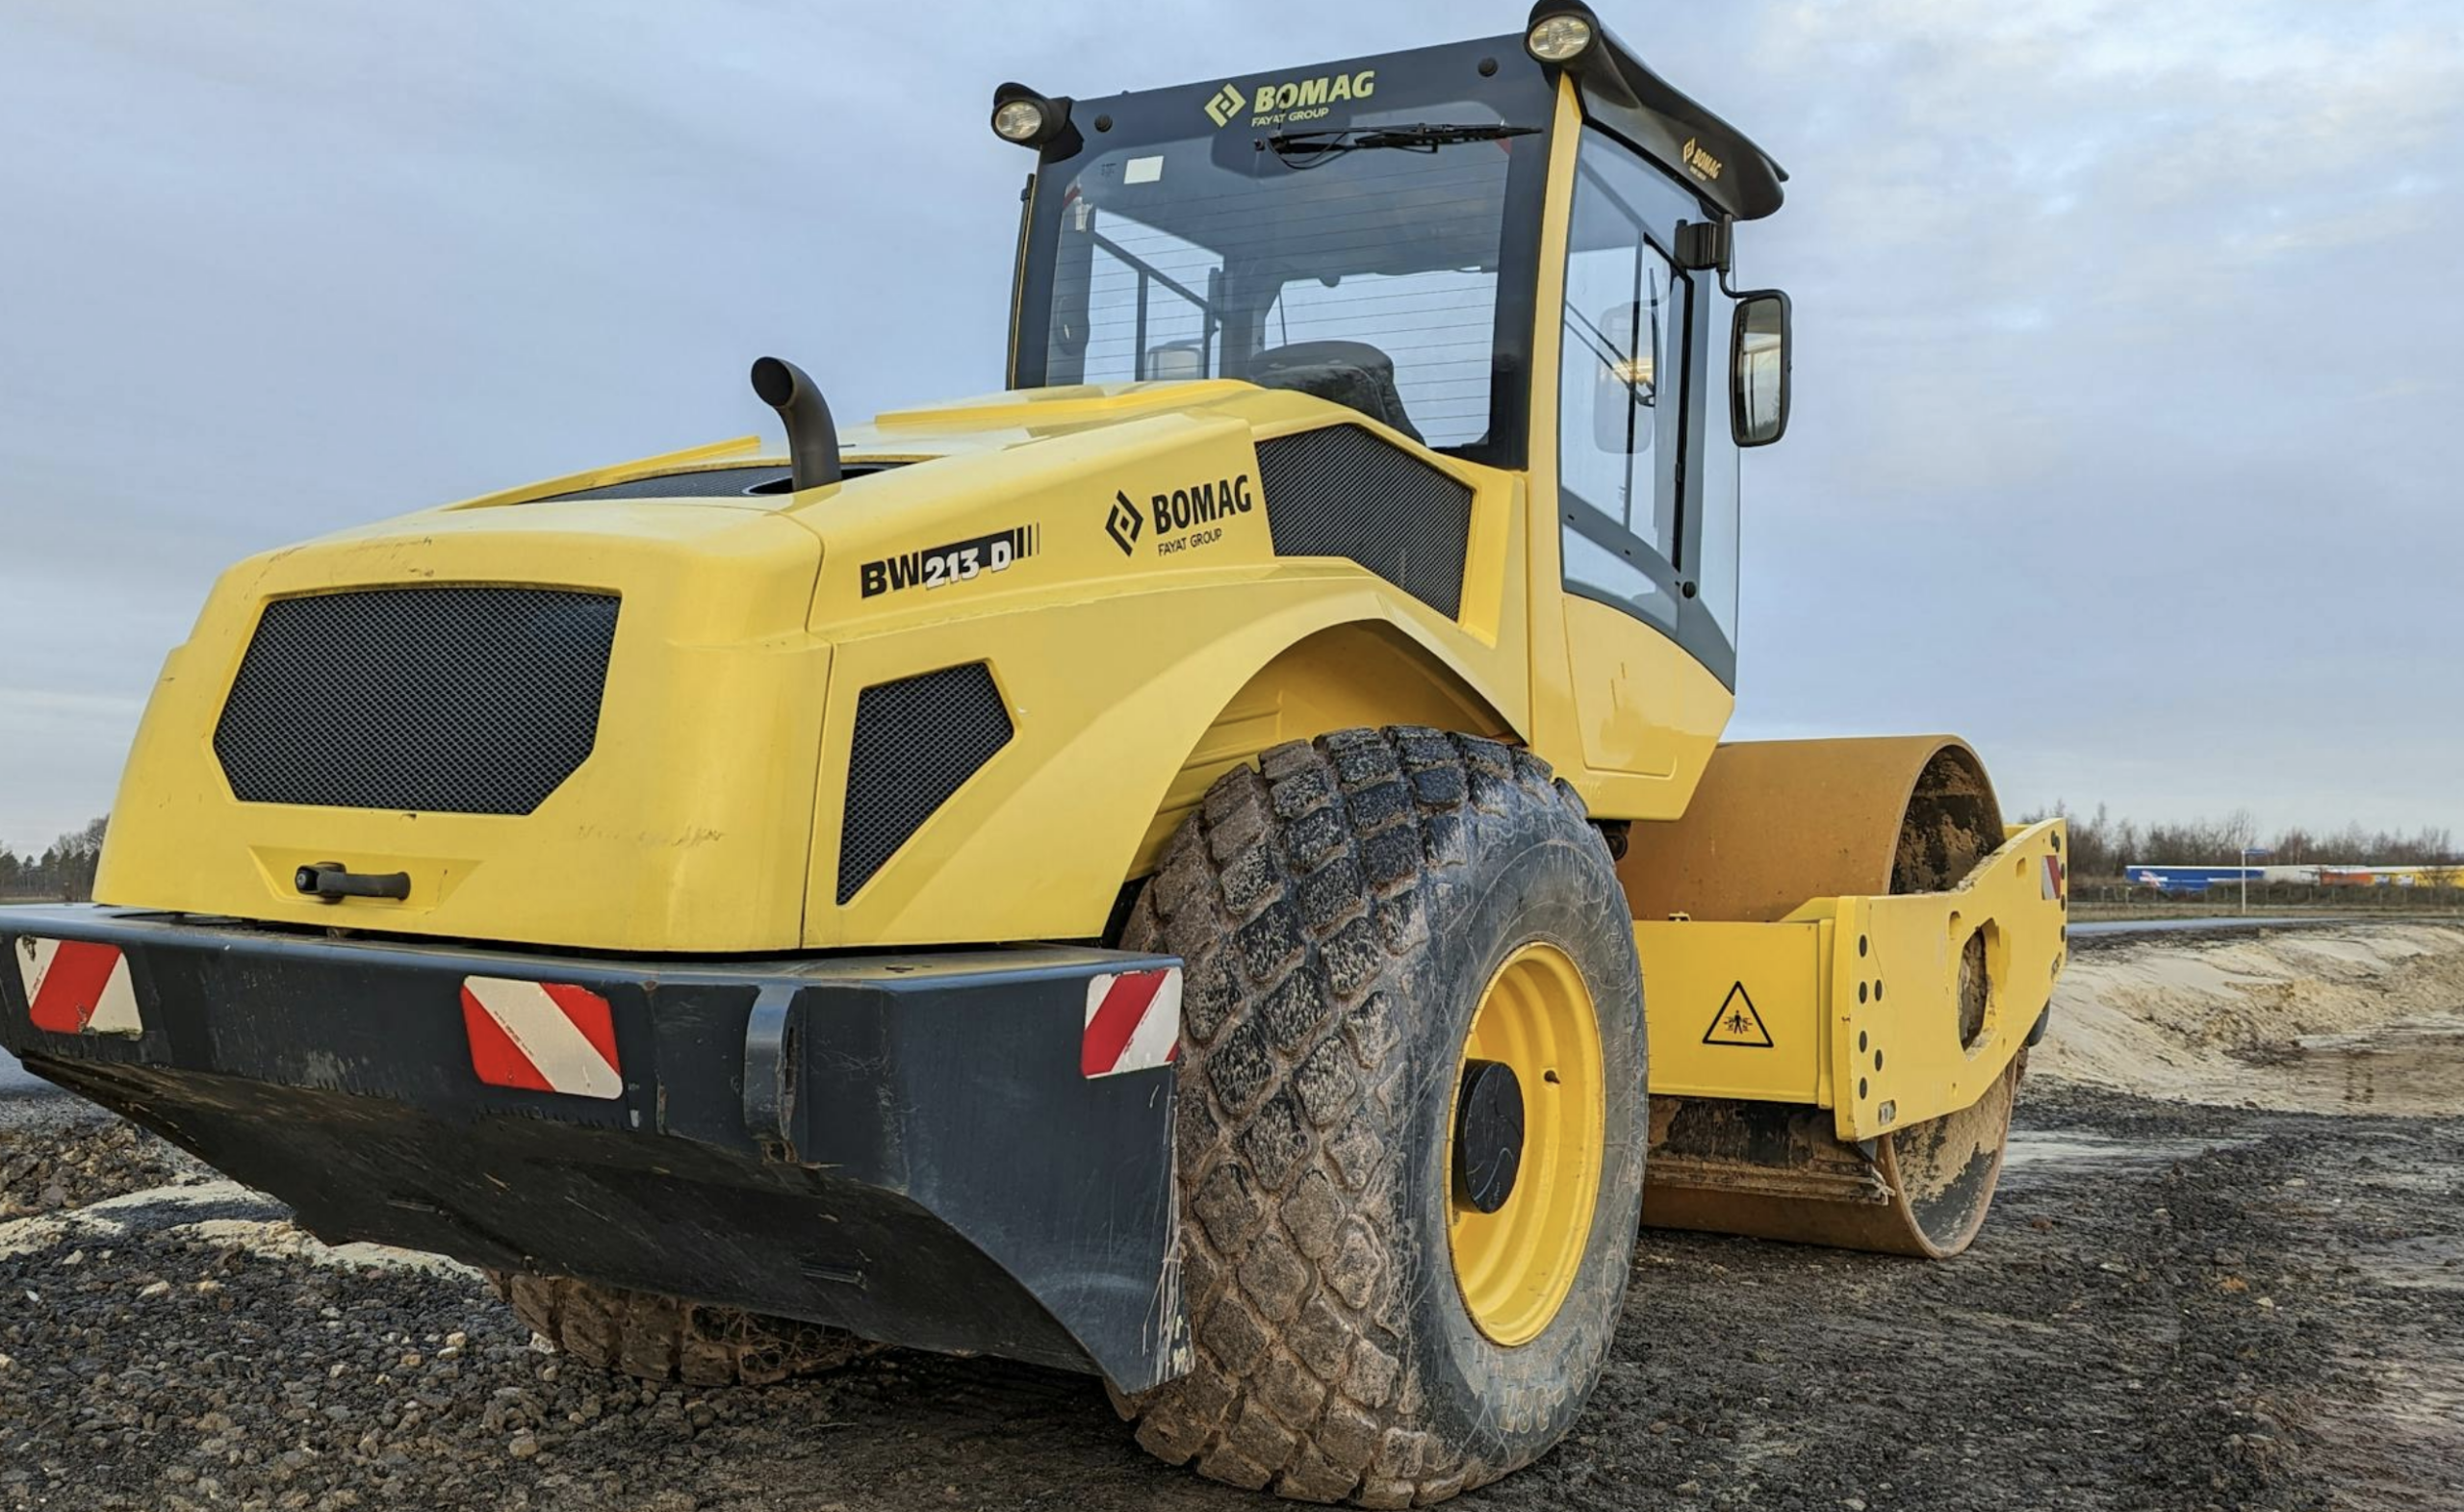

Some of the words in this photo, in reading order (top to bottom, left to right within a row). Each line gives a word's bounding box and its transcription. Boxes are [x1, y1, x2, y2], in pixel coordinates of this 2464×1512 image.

[1254, 70, 1375, 114] BOMAG
[1251, 113, 1286, 127] FAYAT
[1289, 108, 1329, 122] GROUP
[1692, 147, 1723, 179] BOMAG
[1151, 474, 1252, 536] BOMAG
[990, 539, 1013, 574] D
[1158, 537, 1188, 557] FAYAT
[1190, 527, 1222, 549] GROUP
